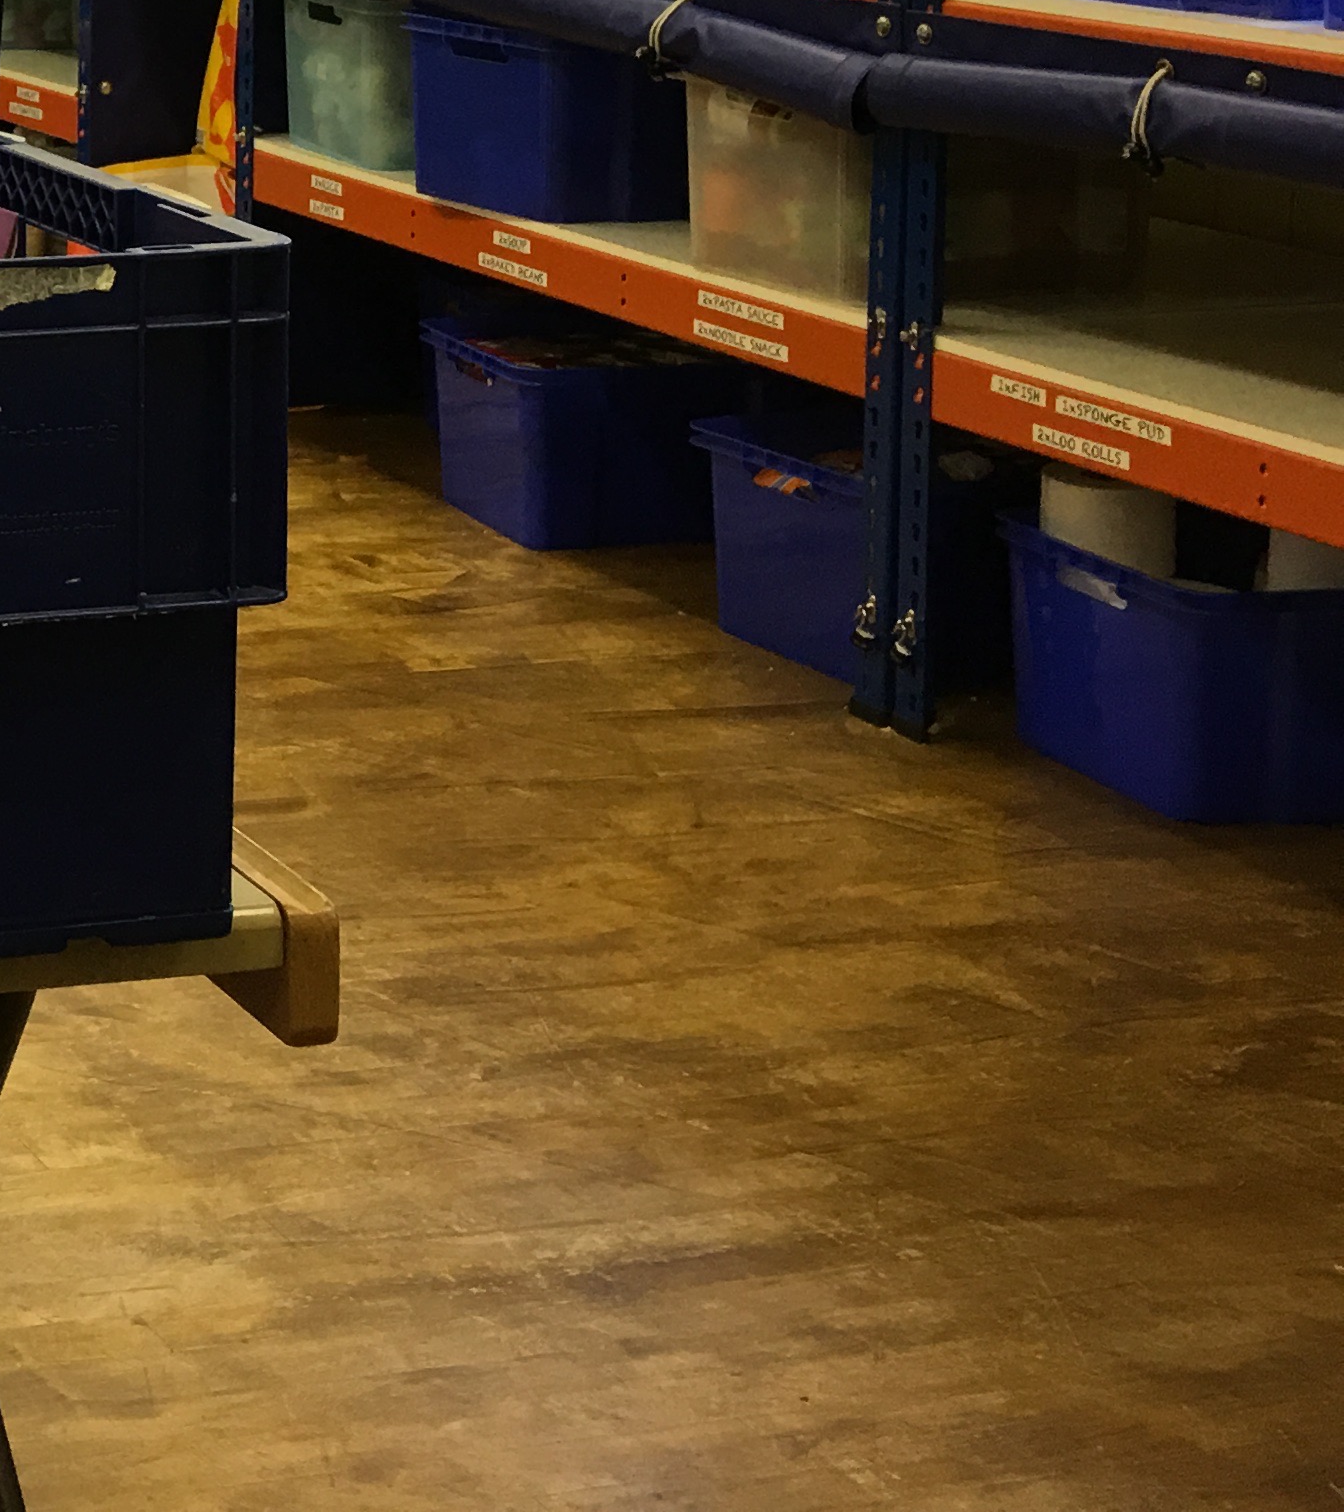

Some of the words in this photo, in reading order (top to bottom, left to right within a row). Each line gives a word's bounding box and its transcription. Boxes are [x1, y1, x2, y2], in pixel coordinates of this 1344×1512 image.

[518, 265, 544, 285] BEANS
[703, 293, 742, 313] 2xPASTA
[747, 306, 779, 326] SAUCE
[698, 322, 746, 348] 2xNOODLE
[750, 338, 782, 357] SNACK
[998, 379, 1040, 403] 1xFISH
[1062, 399, 1132, 431] 1xSPONGE
[1137, 420, 1165, 441] PUD
[1037, 427, 1076, 451] 2xLOO
[1081, 440, 1121, 466] ROLLS
